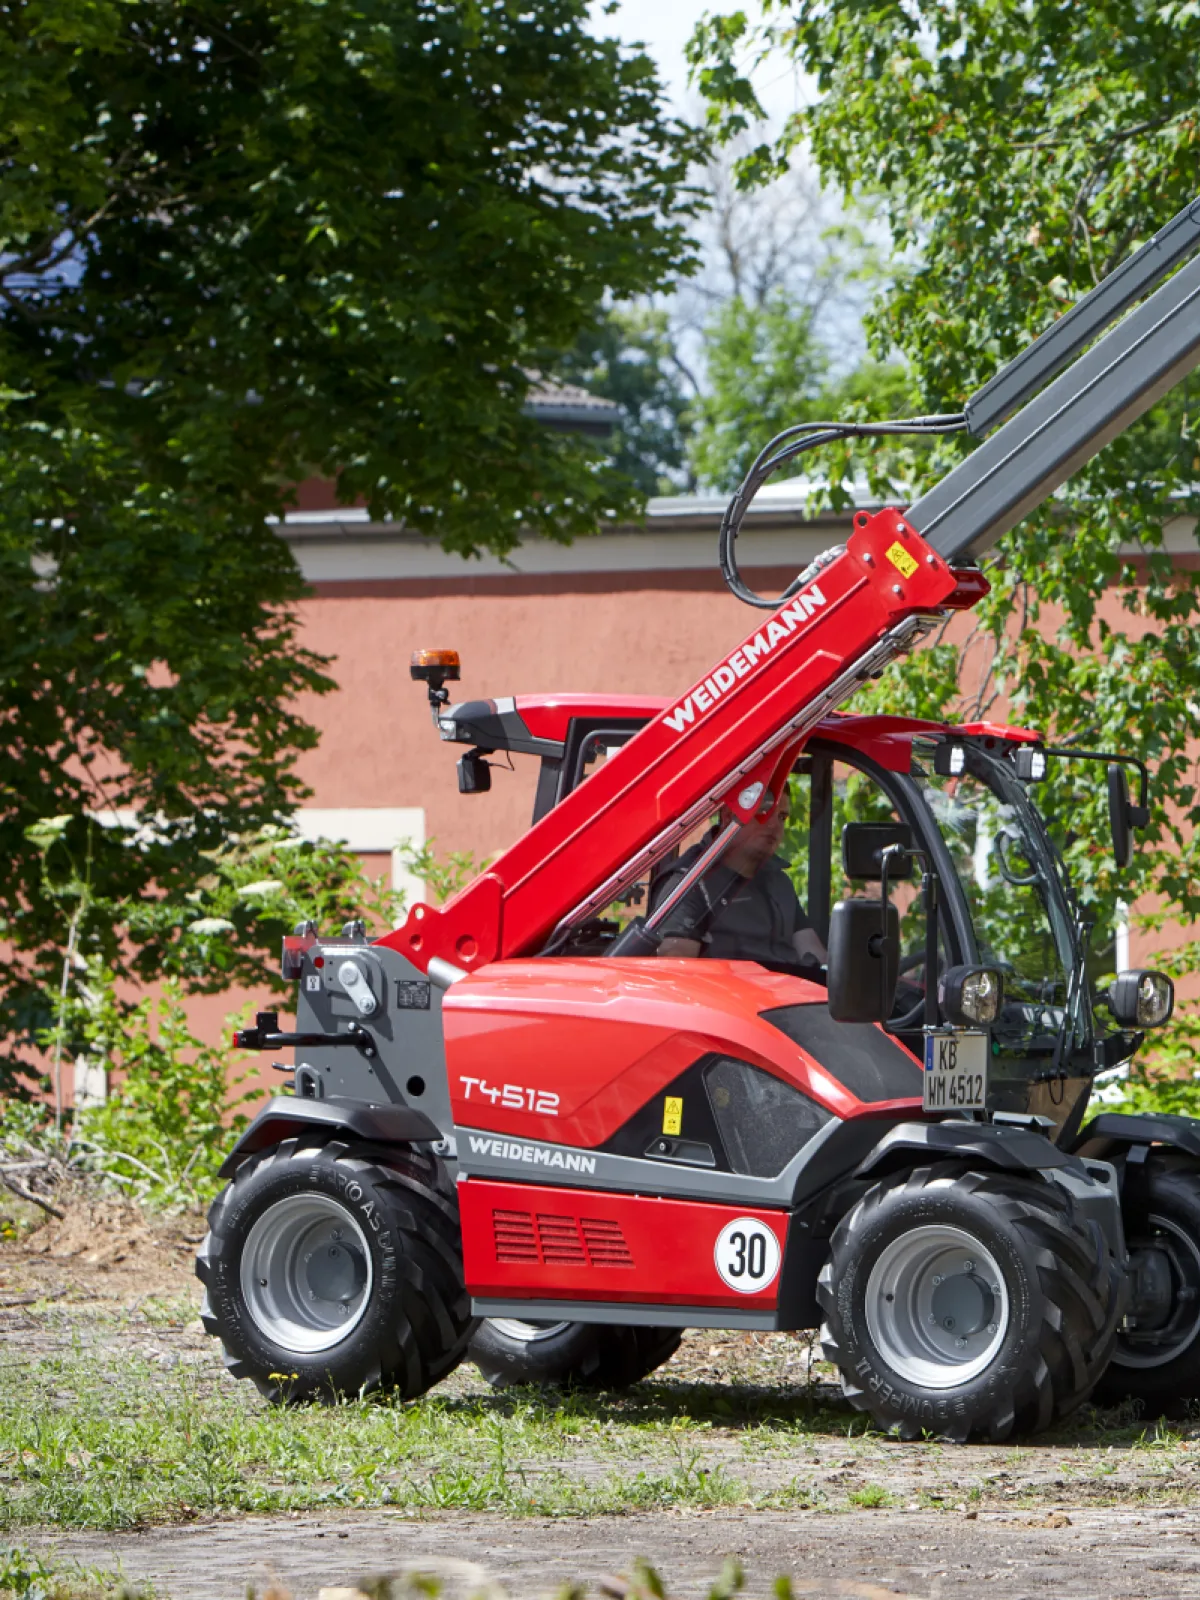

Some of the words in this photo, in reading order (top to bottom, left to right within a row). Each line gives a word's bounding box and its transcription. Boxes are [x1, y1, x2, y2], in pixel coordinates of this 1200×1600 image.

[662, 583, 828, 733] WEIDEMANN
[939, 1040, 957, 1070] KB
[459, 1075, 560, 1116] T4512
[929, 1075, 946, 1106] WM
[949, 1074, 983, 1105] 4512
[468, 1136, 596, 1175] WEIDEMANN
[728, 1231, 766, 1279] 30
